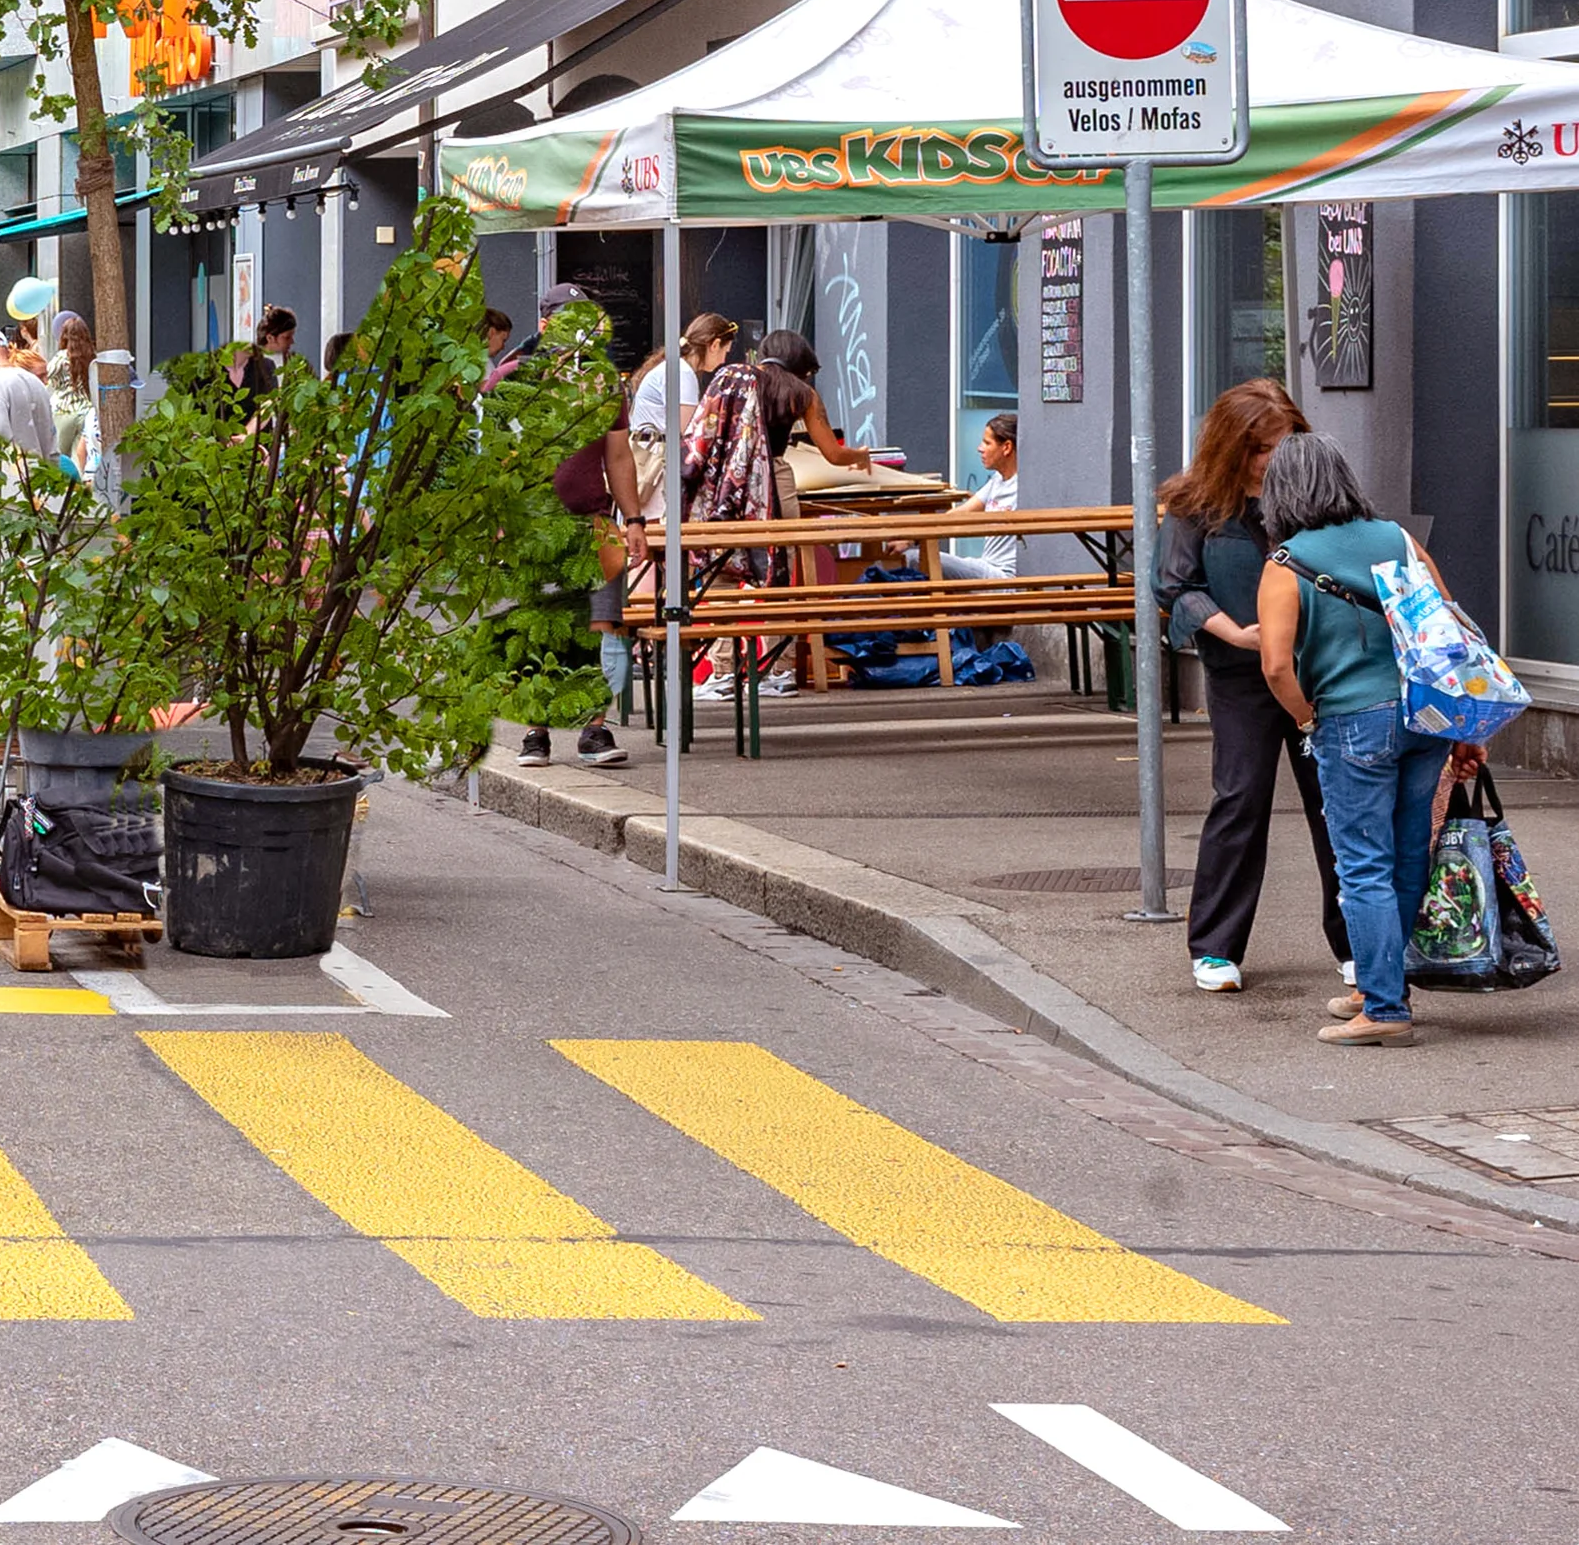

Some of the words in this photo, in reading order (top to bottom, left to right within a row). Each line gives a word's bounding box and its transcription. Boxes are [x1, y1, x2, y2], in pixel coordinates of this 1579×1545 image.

[1063, 78, 1207, 102] ausgenommen
[1068, 108, 1121, 132] Velos
[1127, 107, 1134, 131] /
[1141, 106, 1202, 131] Mofas
[634, 154, 661, 191] UBS
[744, 148, 842, 189] UBS
[844, 129, 1012, 186] KIDS
